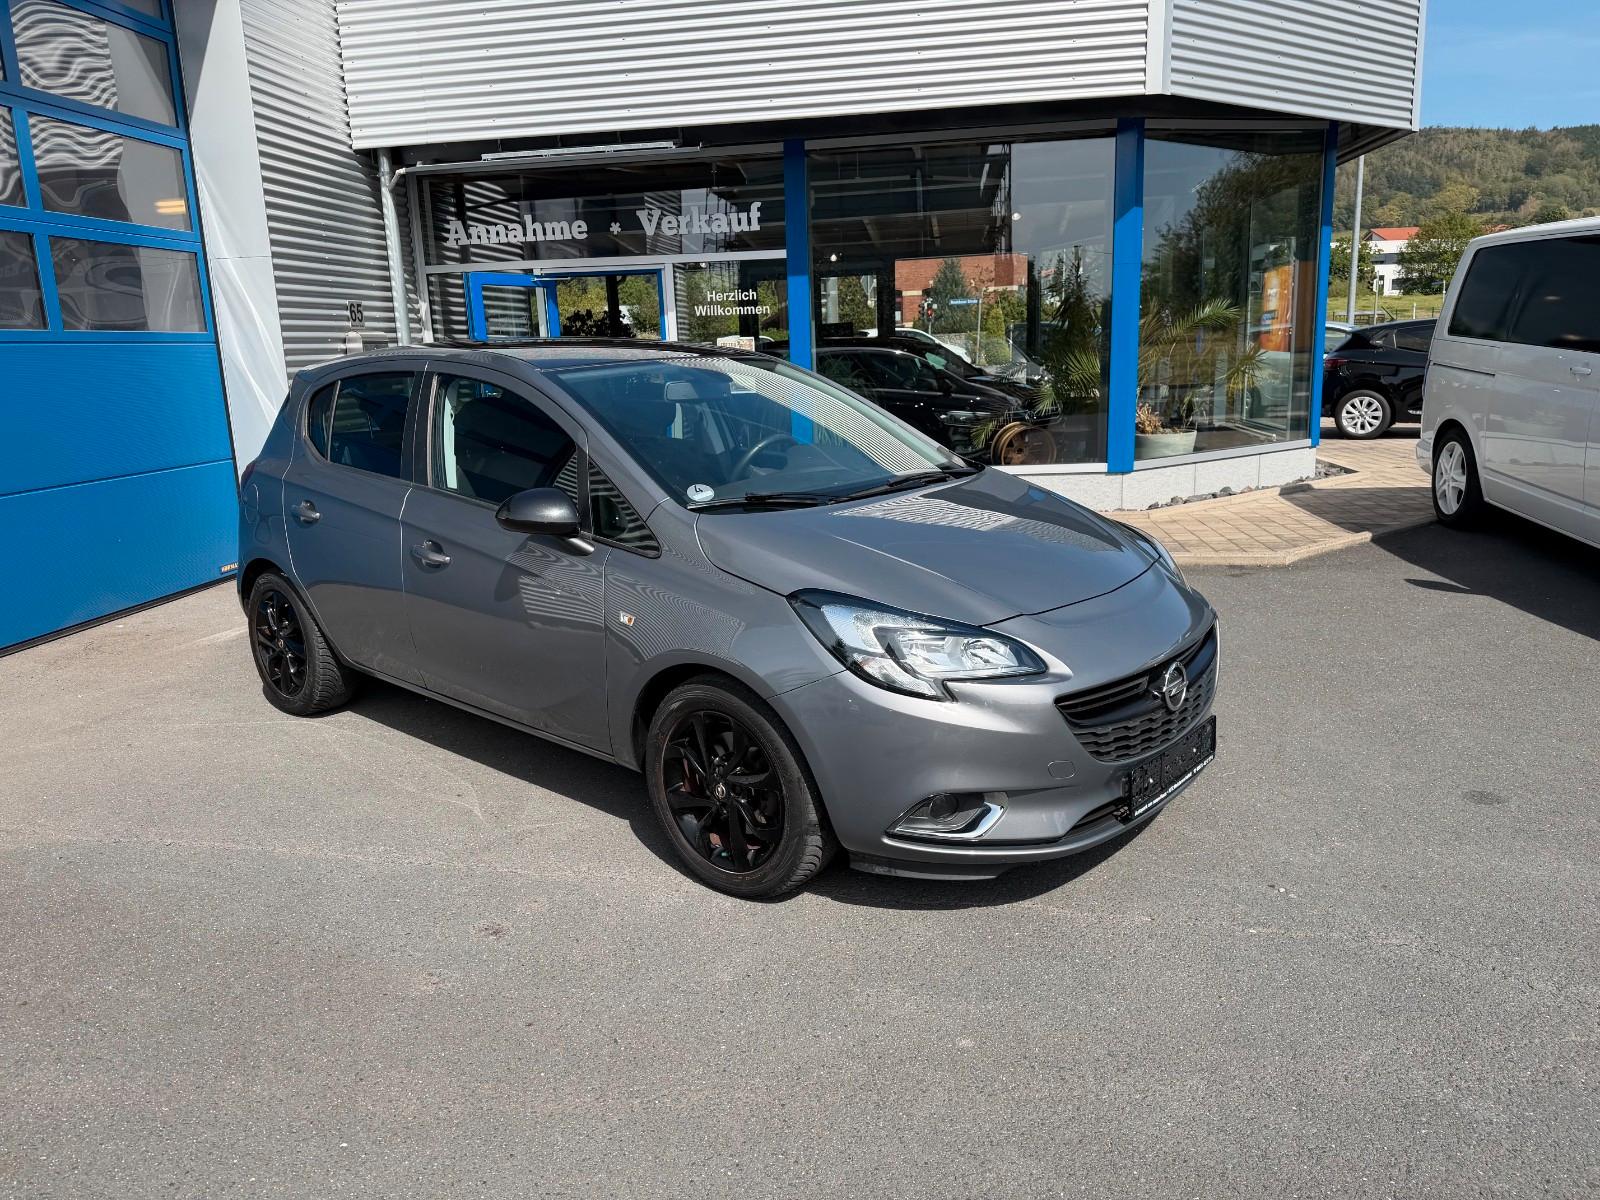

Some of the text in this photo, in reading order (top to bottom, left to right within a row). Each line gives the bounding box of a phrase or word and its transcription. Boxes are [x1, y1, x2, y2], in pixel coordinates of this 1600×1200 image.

[446, 202, 761, 246] Annahme Verkauf
[706, 289, 758, 302] Herzlich
[350, 303, 363, 322] 65
[694, 303, 771, 317] Willkommen
[694, 485, 703, 493] 4
